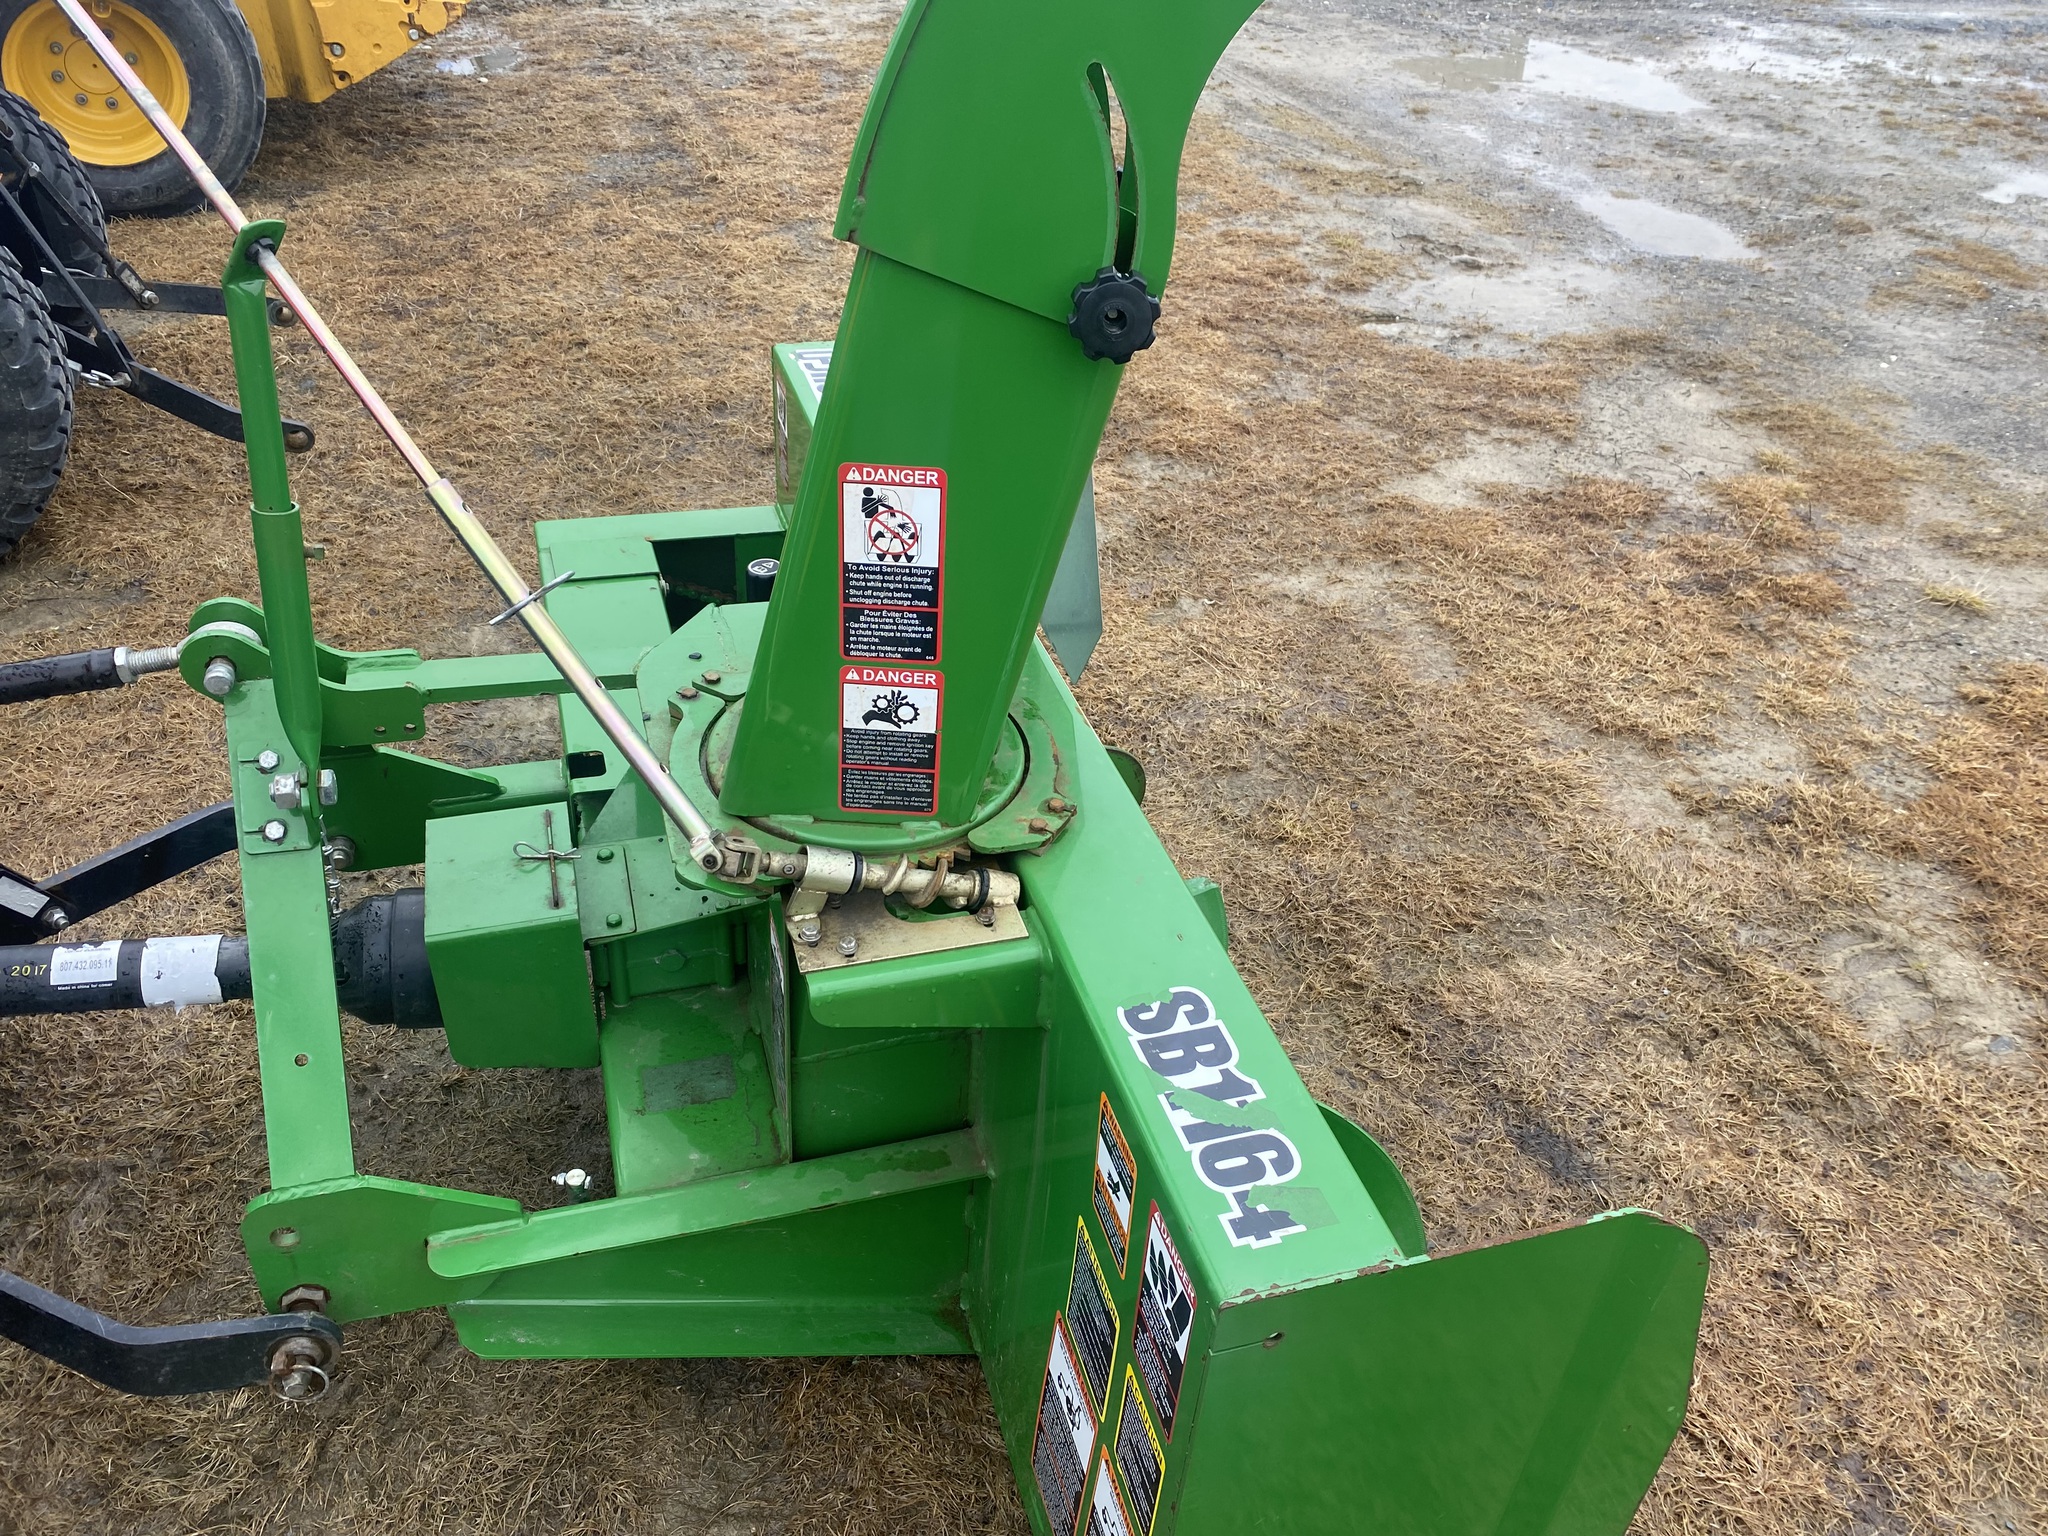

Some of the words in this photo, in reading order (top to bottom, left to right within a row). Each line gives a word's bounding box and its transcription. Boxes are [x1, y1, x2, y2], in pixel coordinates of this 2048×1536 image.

[862, 467, 938, 485] DANGER
[911, 568, 934, 576] Injury:
[883, 581, 901, 589] engine
[849, 596, 880, 604] unclogging
[882, 598, 910, 606] discharge
[898, 624, 924, 632] éloignées
[849, 649, 877, 658] débloquer
[863, 670, 936, 686] DANGER
[11, 964, 47, 976] 2017
[1119, 988, 1303, 1246] SB1164
[1159, 1221, 1196, 1300] DANGER
[1134, 1387, 1162, 1465] CAUTION
